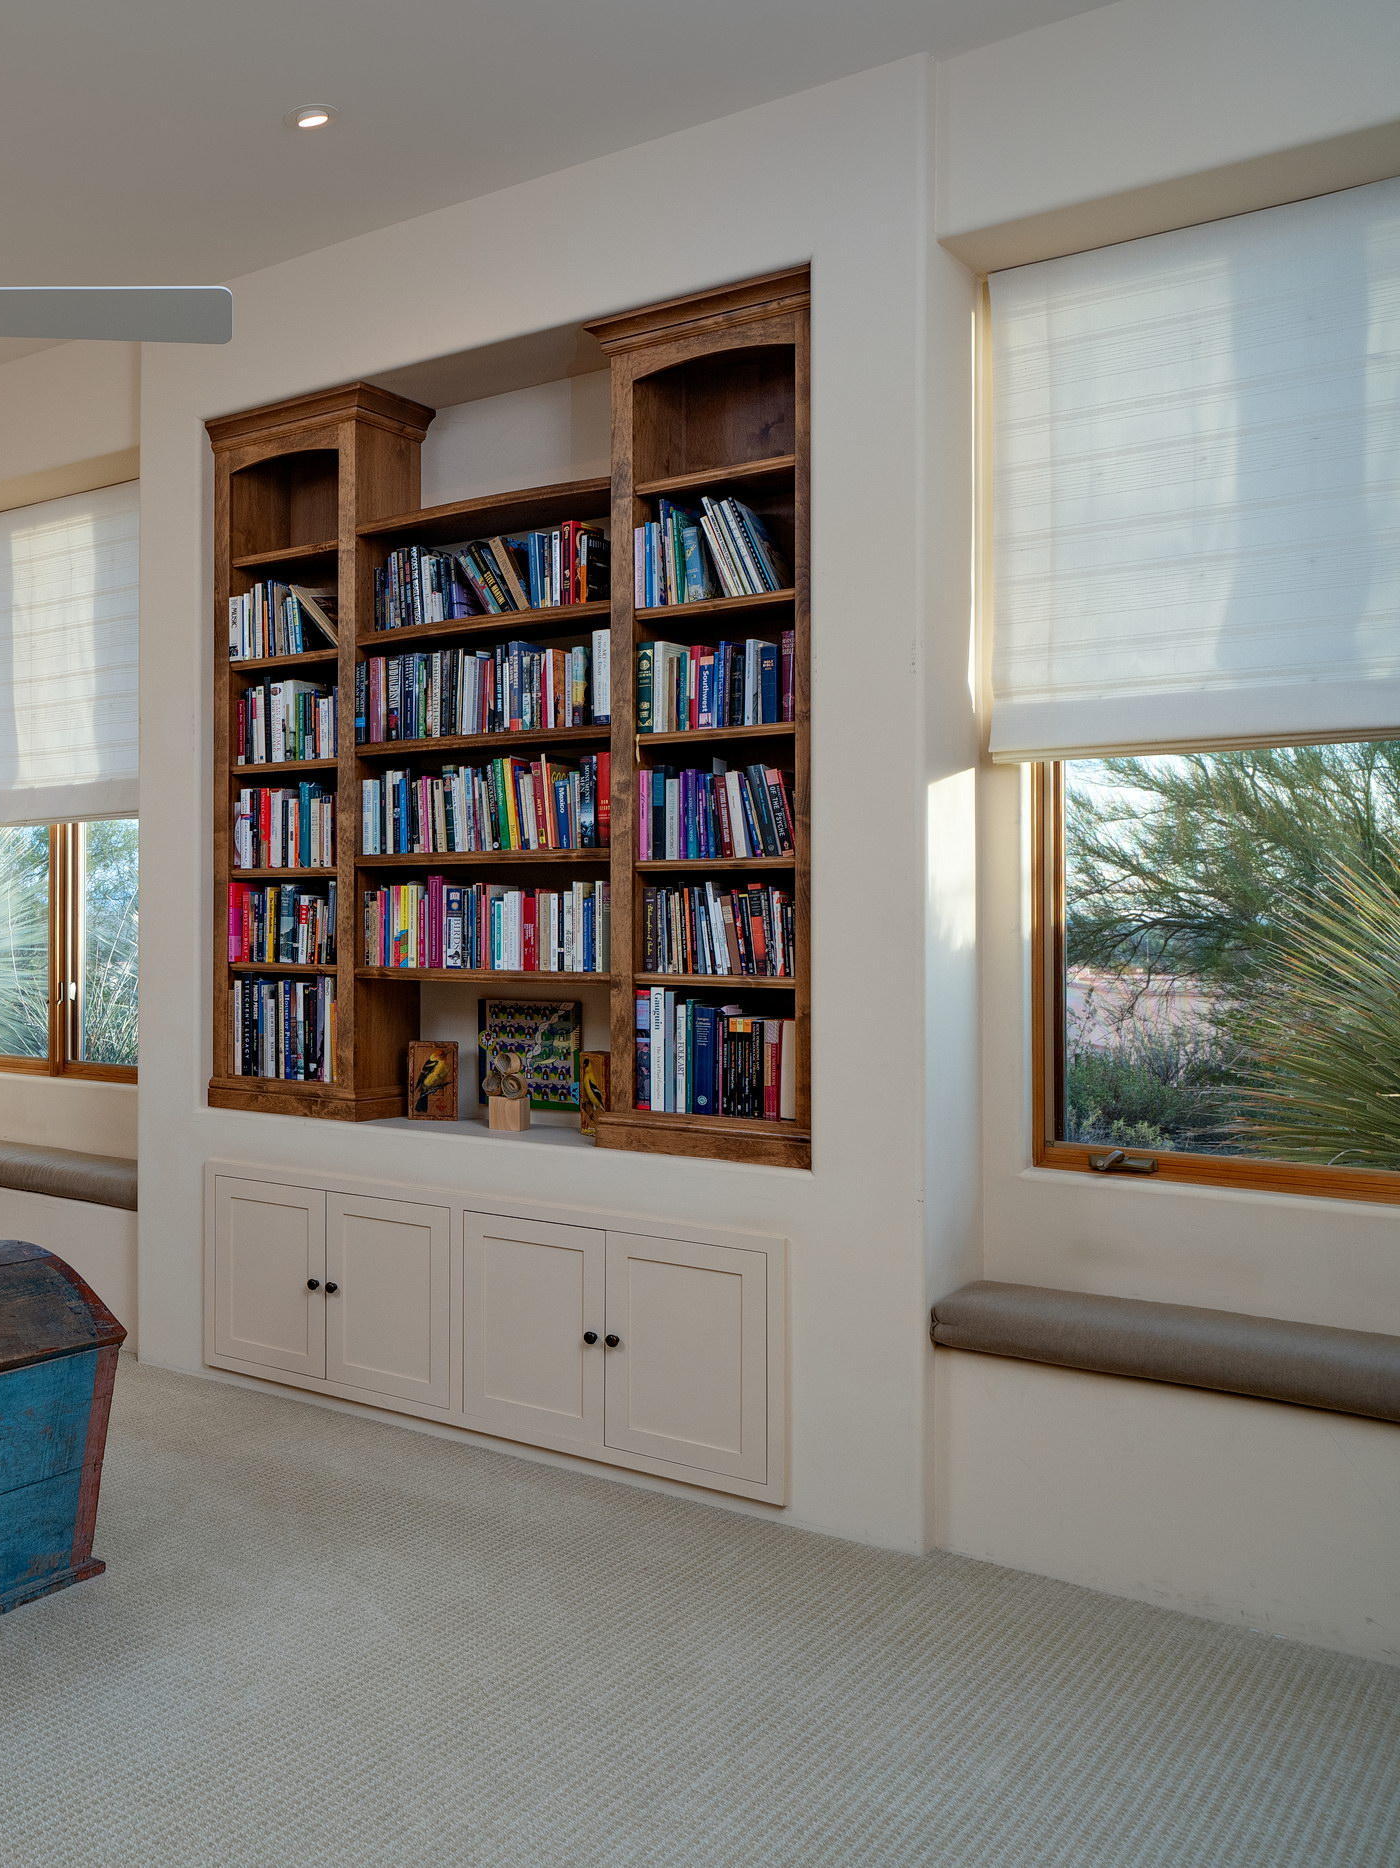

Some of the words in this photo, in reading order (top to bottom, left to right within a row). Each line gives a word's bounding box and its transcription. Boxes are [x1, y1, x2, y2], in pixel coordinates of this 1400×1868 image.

[484, 571, 494, 587] STEVE
[490, 584, 506, 606] MARTINI
[432, 655, 440, 691] FISHING
[701, 670, 709, 713] Southwest
[487, 785, 496, 813] FOLKTALES
[558, 787, 566, 814] Mexico
[769, 786, 776, 795] OF
[771, 797, 780, 810] THE
[775, 812, 786, 837] PSYCHE
[646, 903, 654, 936] Philosophies
[646, 941, 654, 956] India
[653, 992, 663, 1030] Gauguin
[284, 1021, 289, 1029] OF
